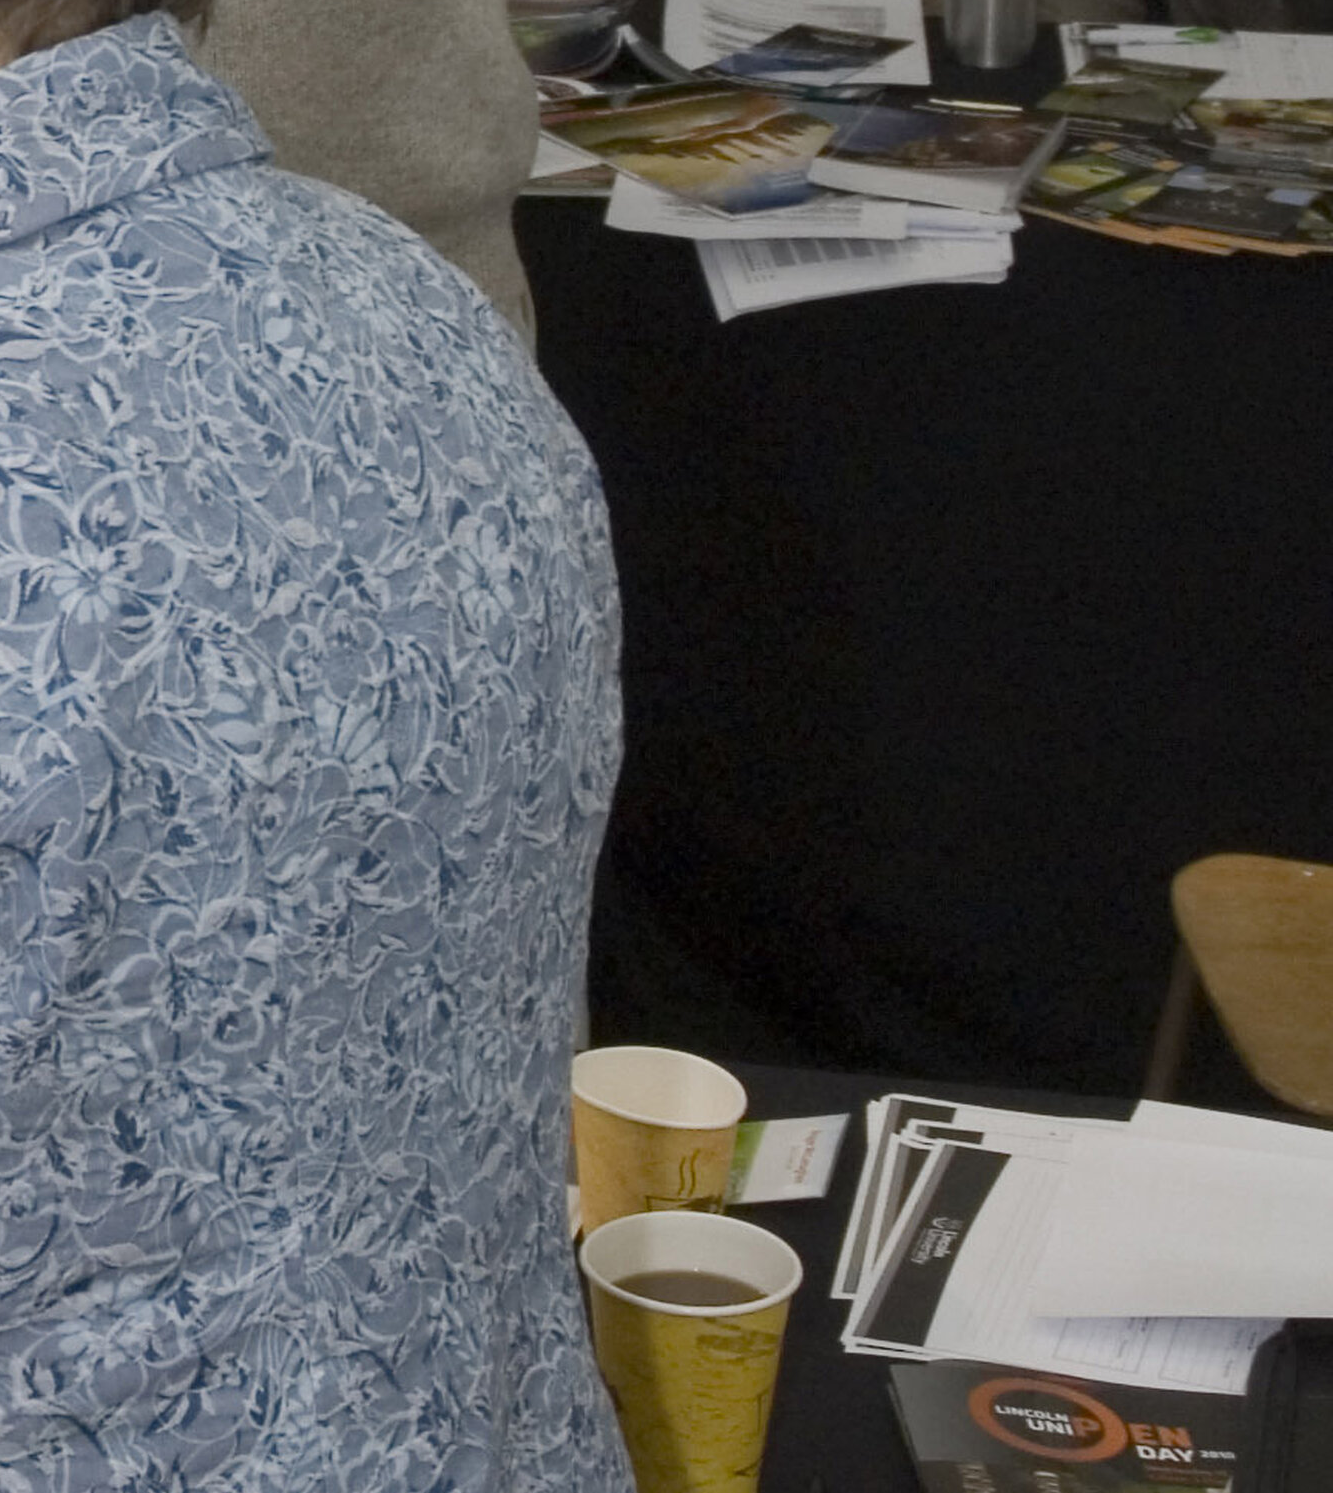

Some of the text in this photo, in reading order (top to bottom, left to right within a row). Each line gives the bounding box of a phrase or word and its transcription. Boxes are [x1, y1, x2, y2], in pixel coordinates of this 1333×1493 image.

[993, 1403, 1070, 1423] LINCOLN
[1026, 1416, 1075, 1438] UNI
[1135, 1444, 1194, 1463] DAY
